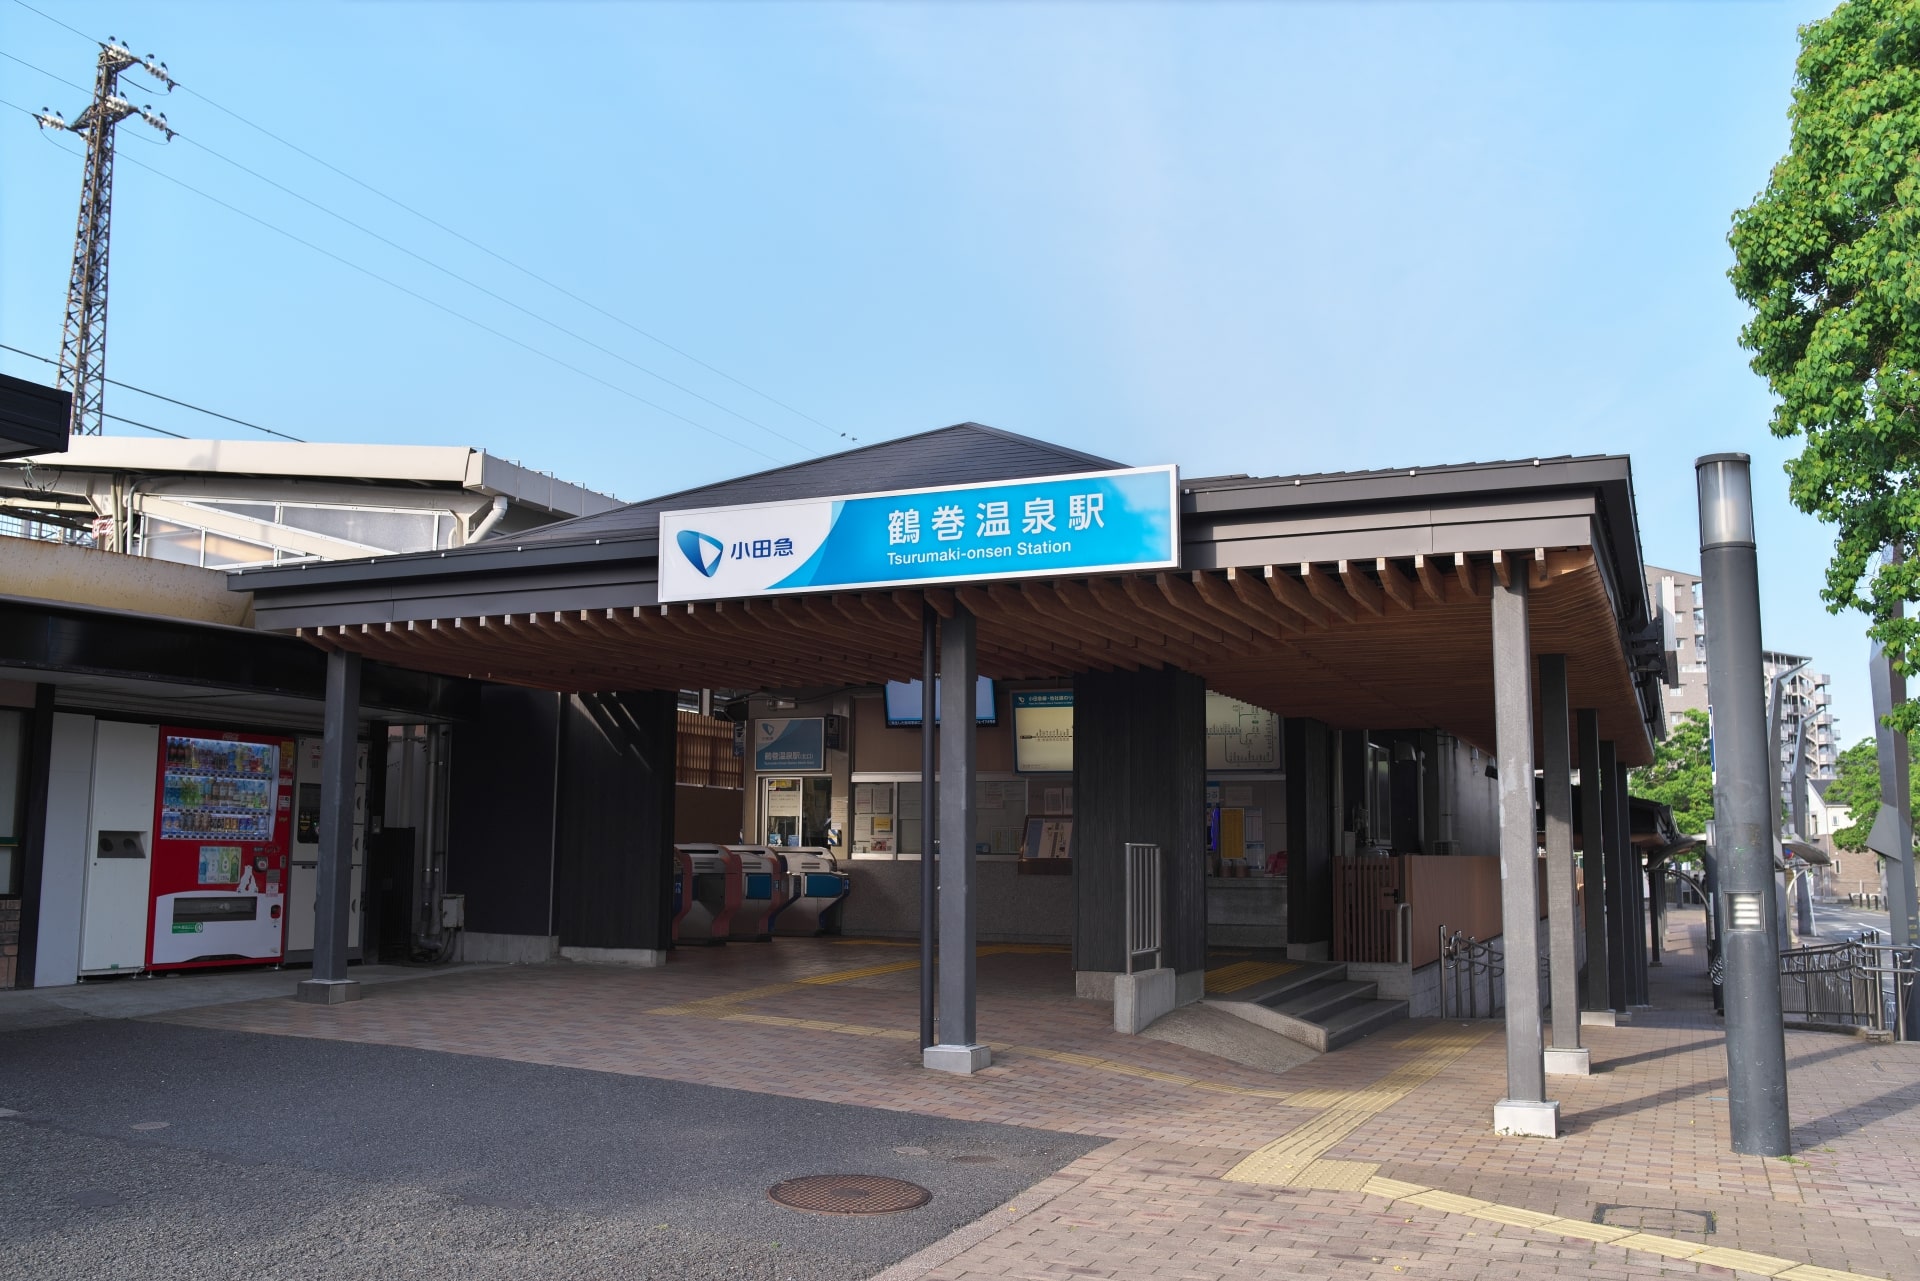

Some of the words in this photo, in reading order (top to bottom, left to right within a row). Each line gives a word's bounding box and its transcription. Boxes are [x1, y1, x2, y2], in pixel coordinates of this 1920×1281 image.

[887, 493, 1105, 546] 鶴巻温泉駅
[730, 537, 794, 560] 小田急
[887, 547, 1012, 566] Tsurumaki-onsen
[1017, 540, 1071, 556] Station
